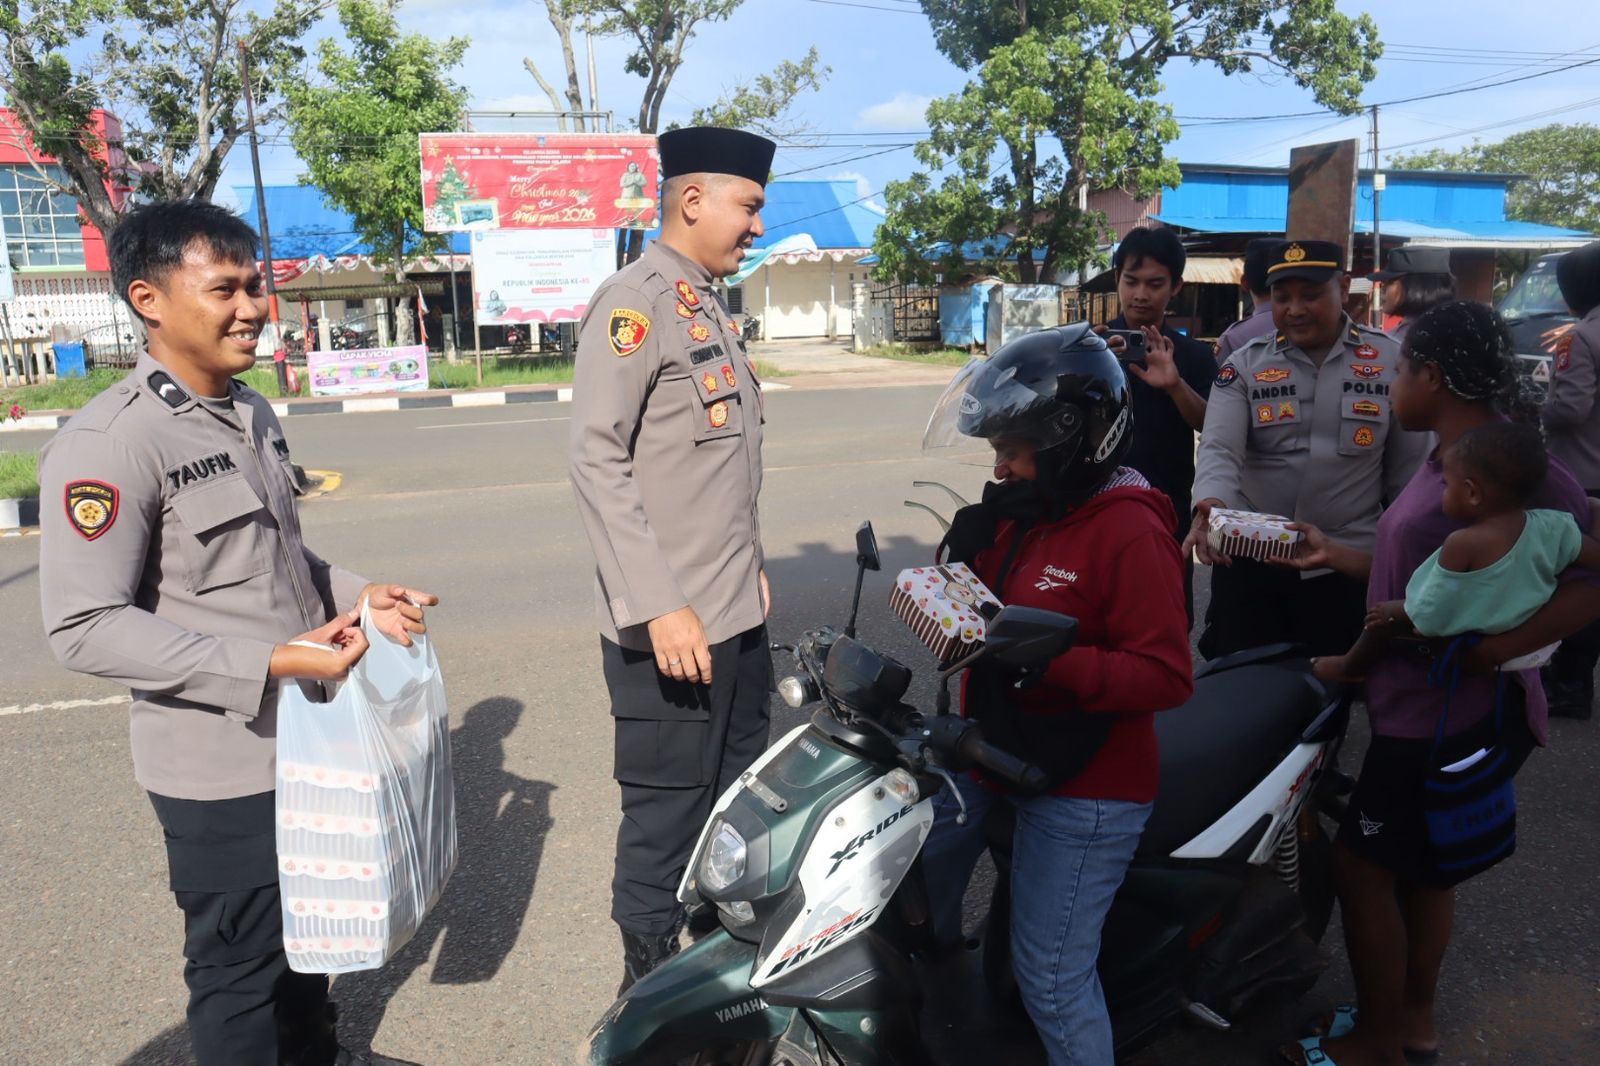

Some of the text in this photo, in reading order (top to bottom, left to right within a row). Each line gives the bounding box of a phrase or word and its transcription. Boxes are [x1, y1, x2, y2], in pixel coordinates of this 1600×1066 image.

[510, 175, 531, 183] Merry
[510, 182, 566, 198] Christmas
[562, 207, 596, 222] 2026
[502, 279, 534, 287] REPUBLIK
[535, 278, 569, 286] INDONESIA
[1252, 384, 1296, 400] ANDRE
[1343, 382, 1389, 396] POLRI
[1099, 408, 1127, 458] INK
[167, 452, 237, 489] TAUFIK
[1043, 564, 1078, 582] Reebok
[714, 997, 769, 1023] YAMAHA
